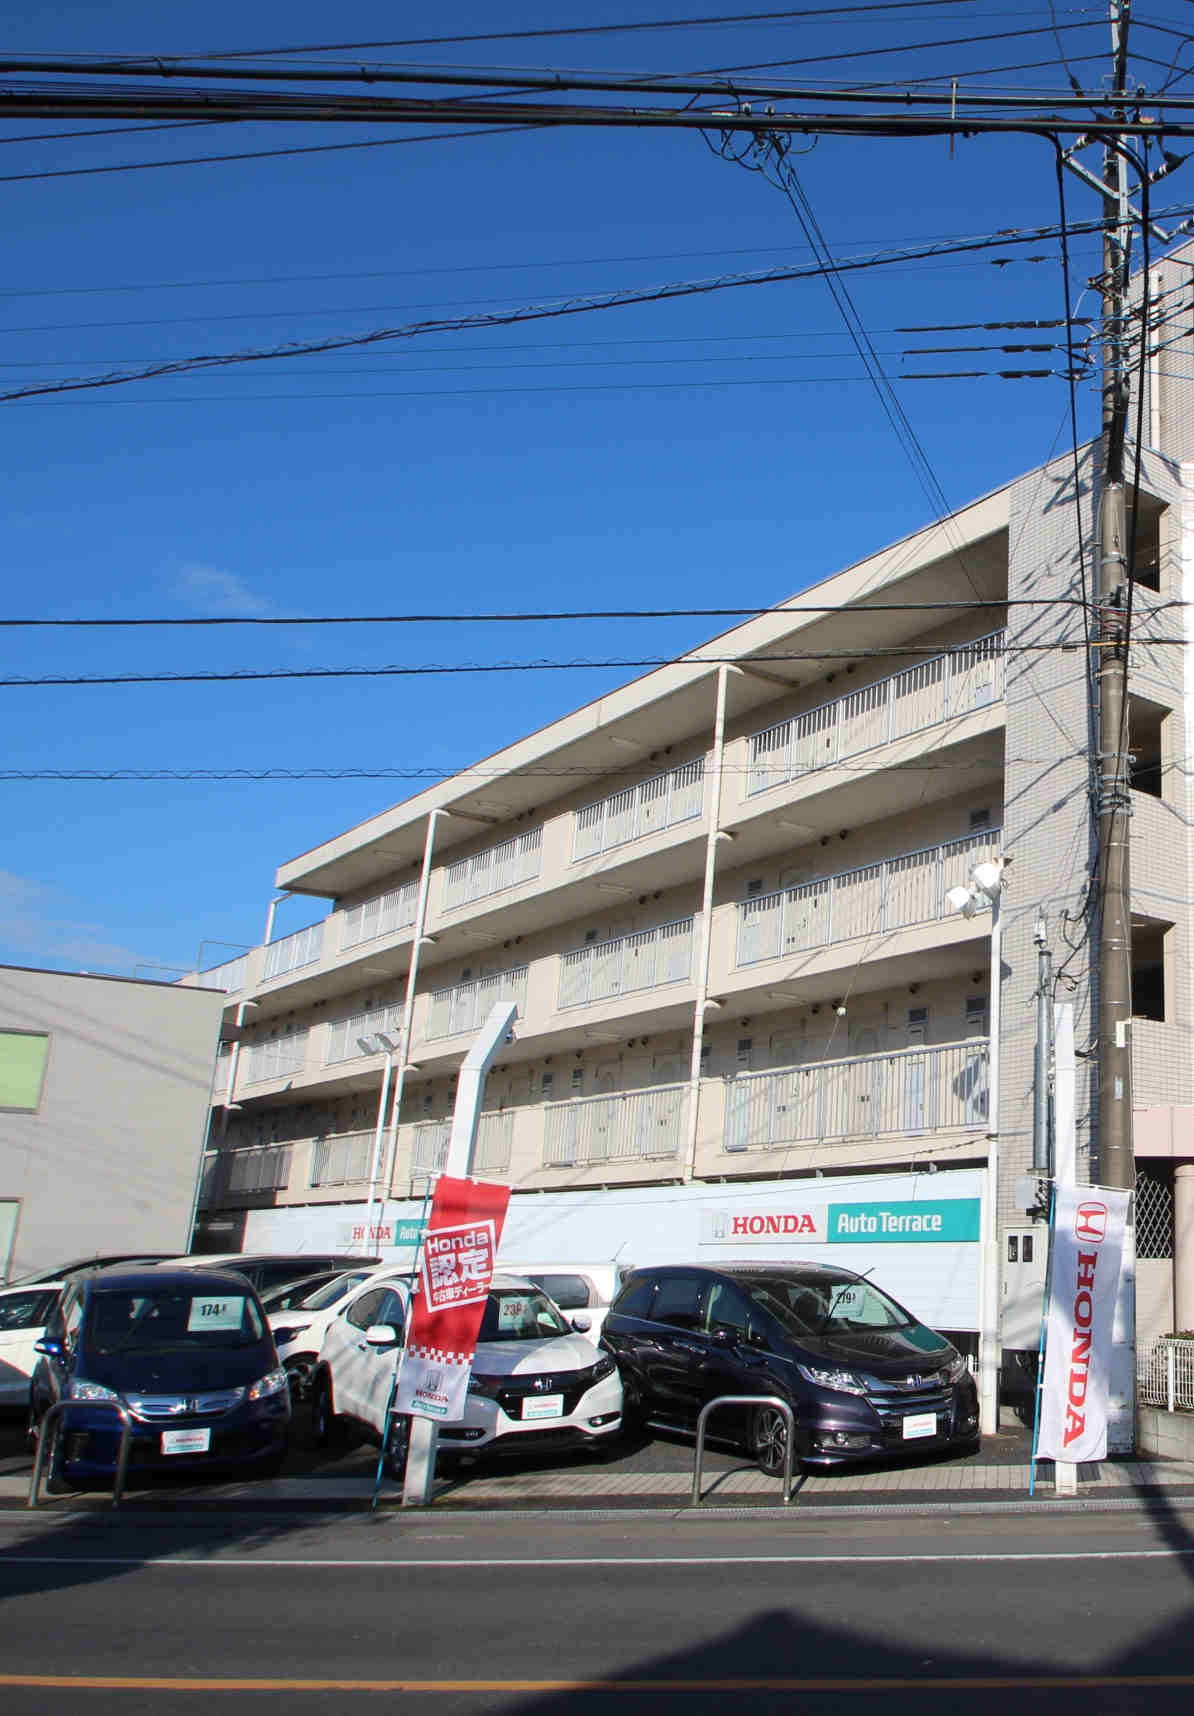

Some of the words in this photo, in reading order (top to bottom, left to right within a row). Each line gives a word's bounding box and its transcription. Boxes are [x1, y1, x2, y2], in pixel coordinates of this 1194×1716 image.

[731, 1214, 817, 1235] HONDA
[837, 1212, 877, 1233] Auto
[879, 1212, 943, 1233] Terrace
[427, 1230, 488, 1255] Honda
[430, 1248, 491, 1290] 認定
[1063, 1250, 1098, 1449] HONDA
